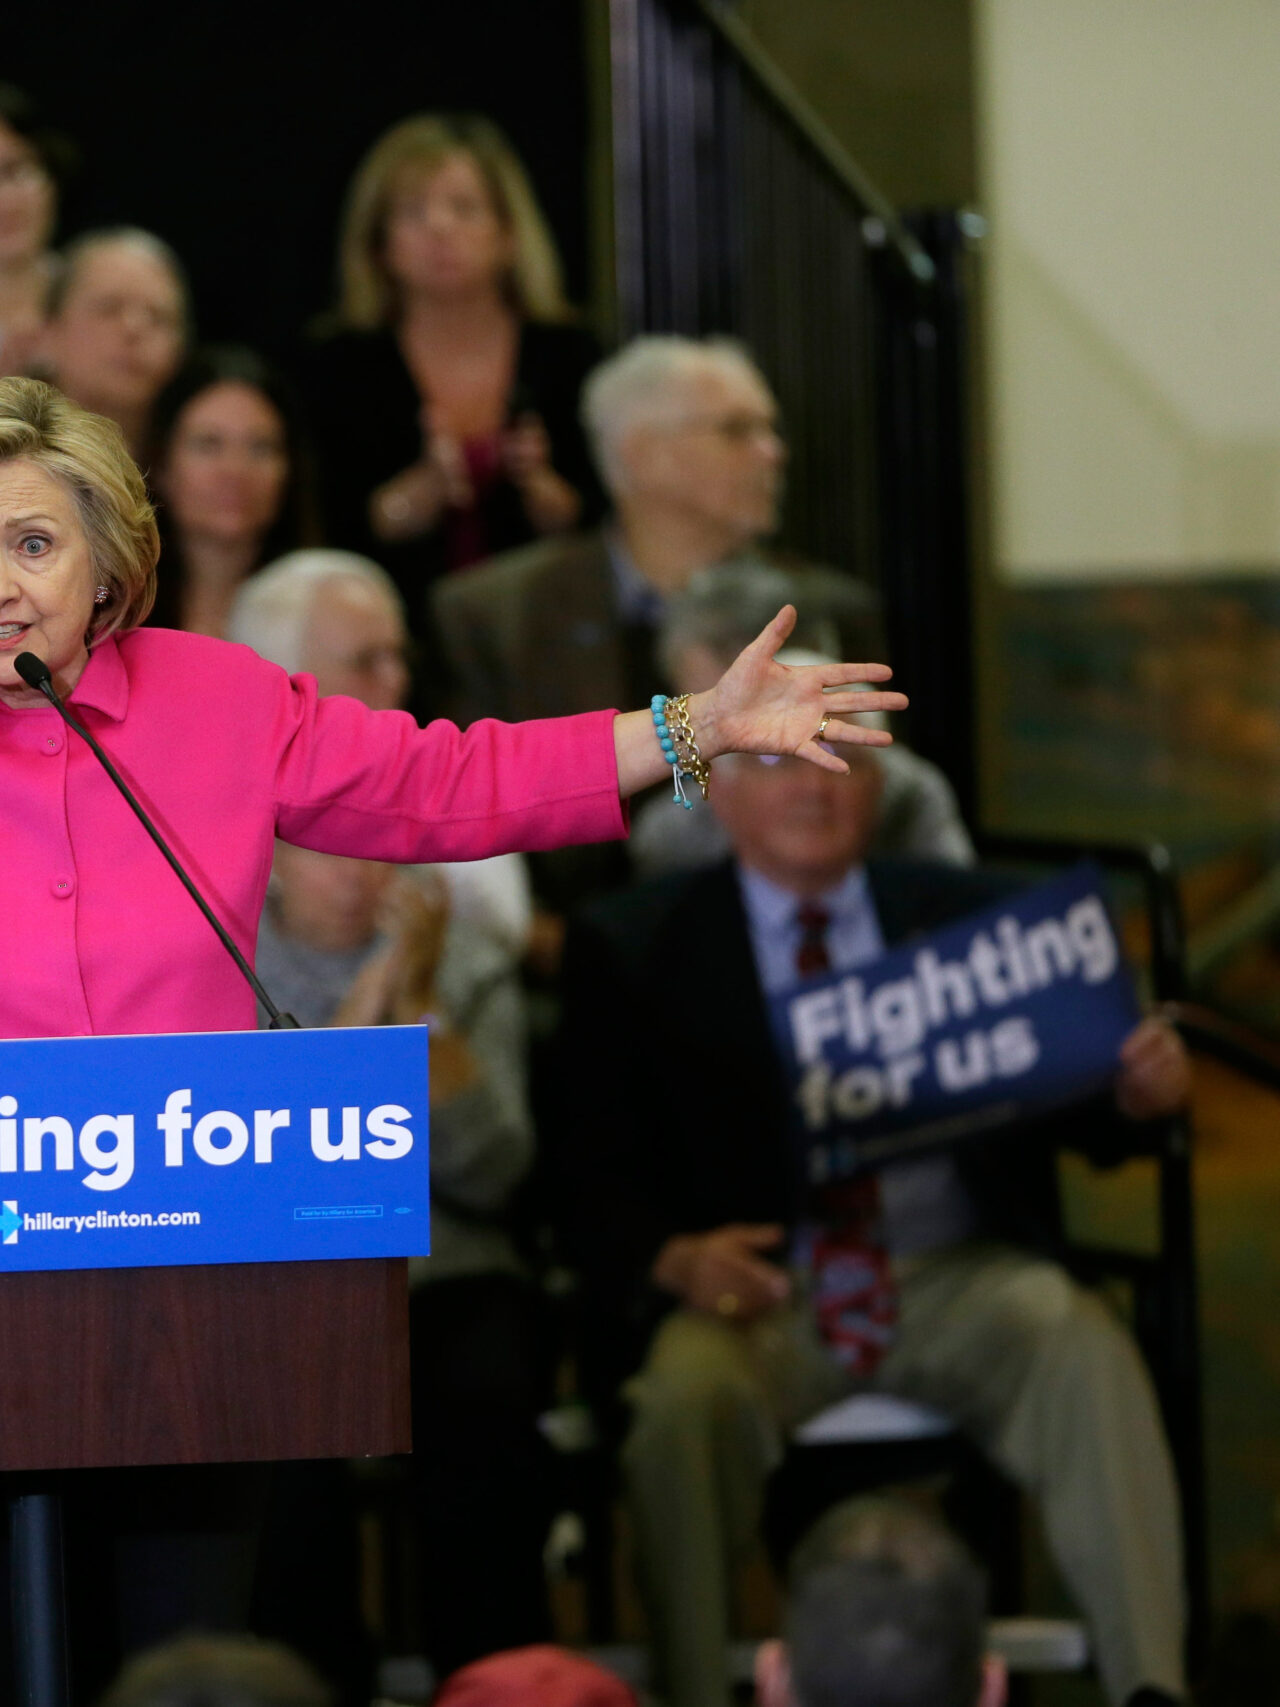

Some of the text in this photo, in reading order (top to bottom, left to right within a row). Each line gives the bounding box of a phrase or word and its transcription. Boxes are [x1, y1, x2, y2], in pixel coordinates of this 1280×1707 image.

[788, 895, 1119, 1063] Fighting
[799, 1052, 924, 1129] for
[934, 1017, 1040, 1093] us
[156, 1088, 291, 1167] for
[310, 1104, 414, 1162] us
[23, 1210, 201, 1233] hillaryclinton.com
